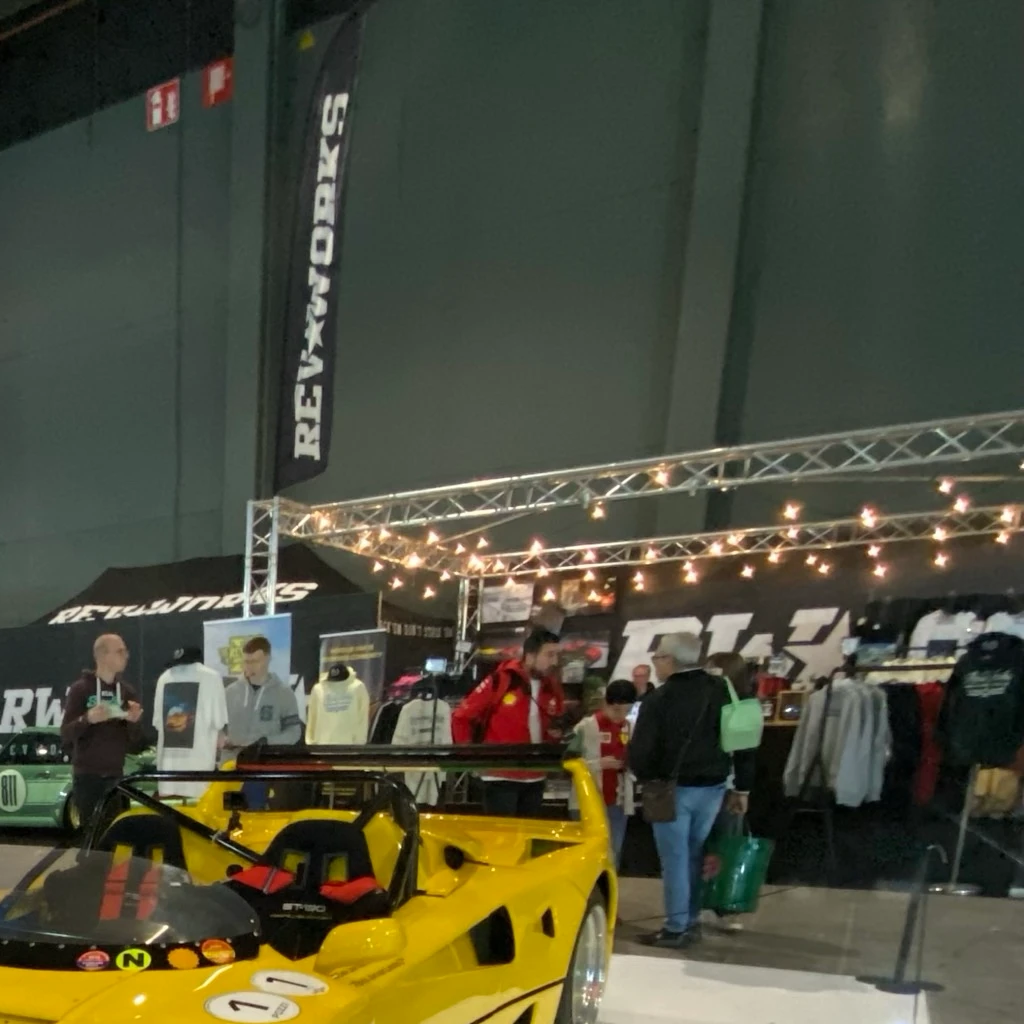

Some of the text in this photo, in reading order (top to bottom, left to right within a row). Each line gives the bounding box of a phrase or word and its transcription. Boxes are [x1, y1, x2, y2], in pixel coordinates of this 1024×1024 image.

[0, 773, 18, 807] 811
[122, 952, 145, 968] N
[228, 999, 270, 1012] 1
